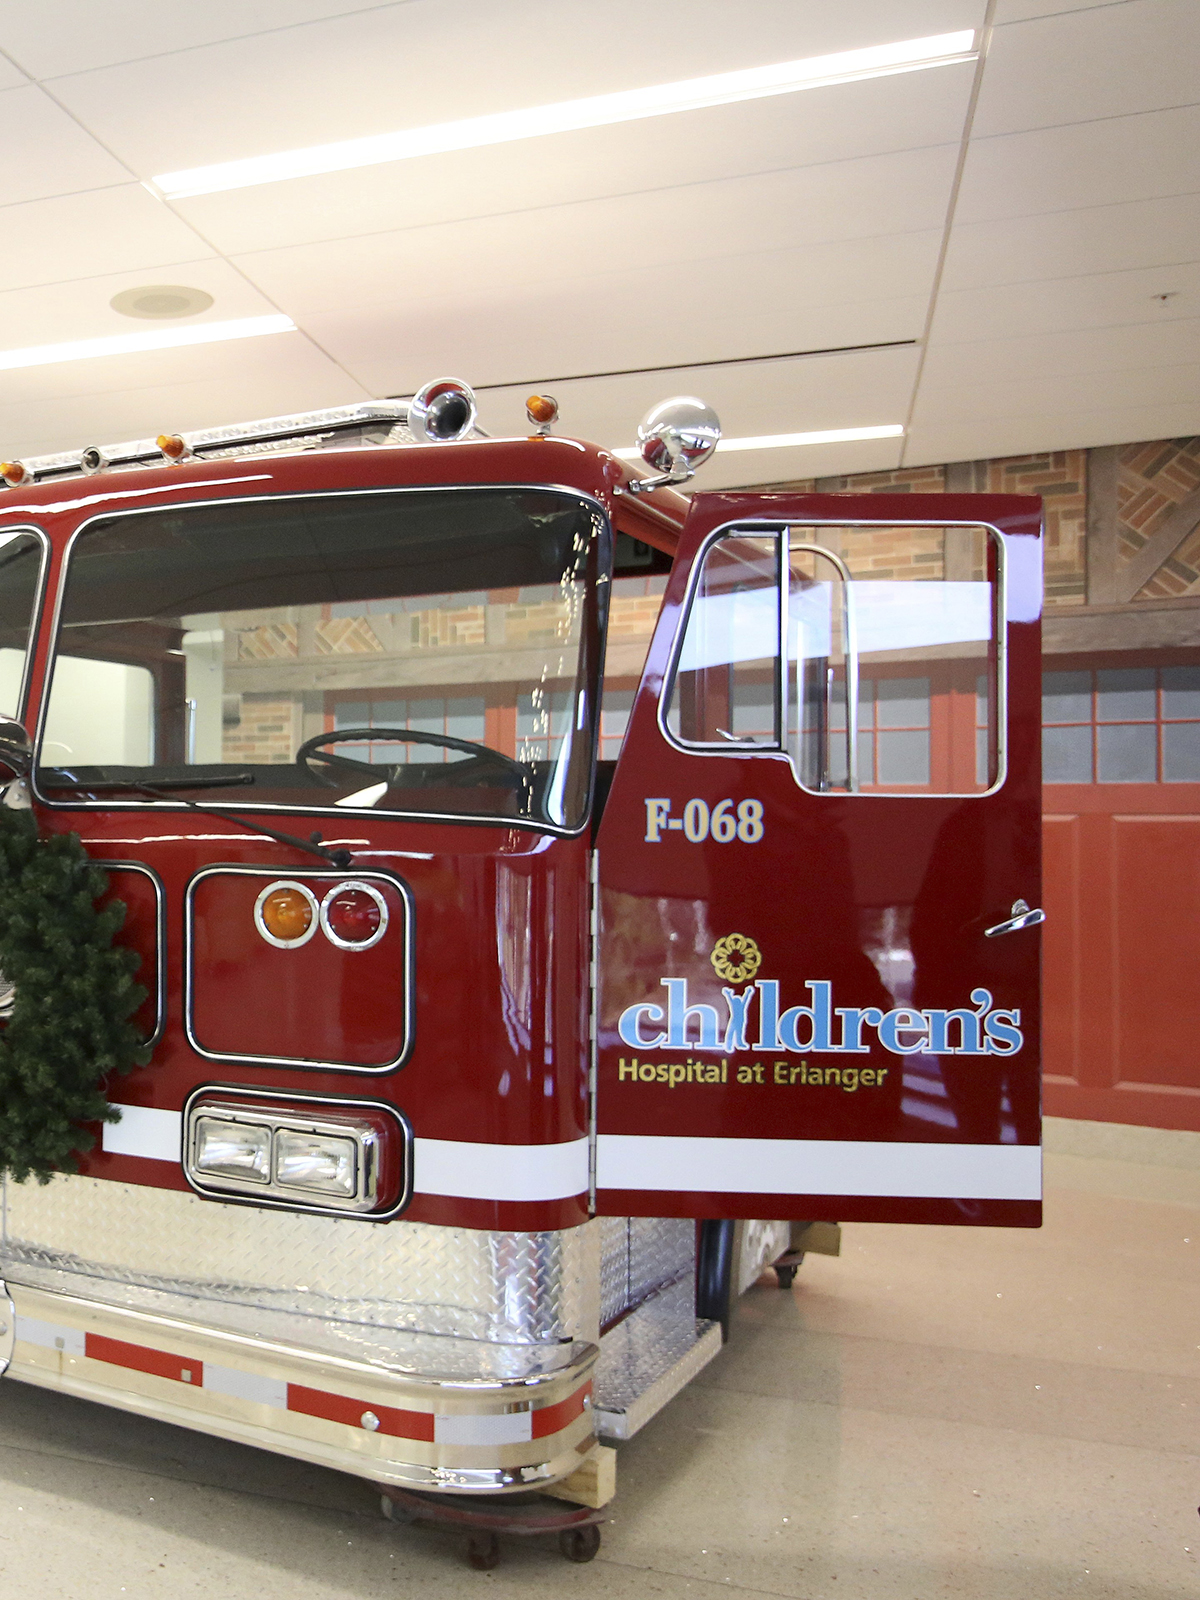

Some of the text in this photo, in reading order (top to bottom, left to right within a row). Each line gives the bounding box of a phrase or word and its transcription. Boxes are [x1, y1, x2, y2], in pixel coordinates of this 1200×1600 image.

[645, 799, 763, 842] F-068
[619, 979, 1022, 1055] children's
[618, 1059, 887, 1091] Hospital at Erlanger
